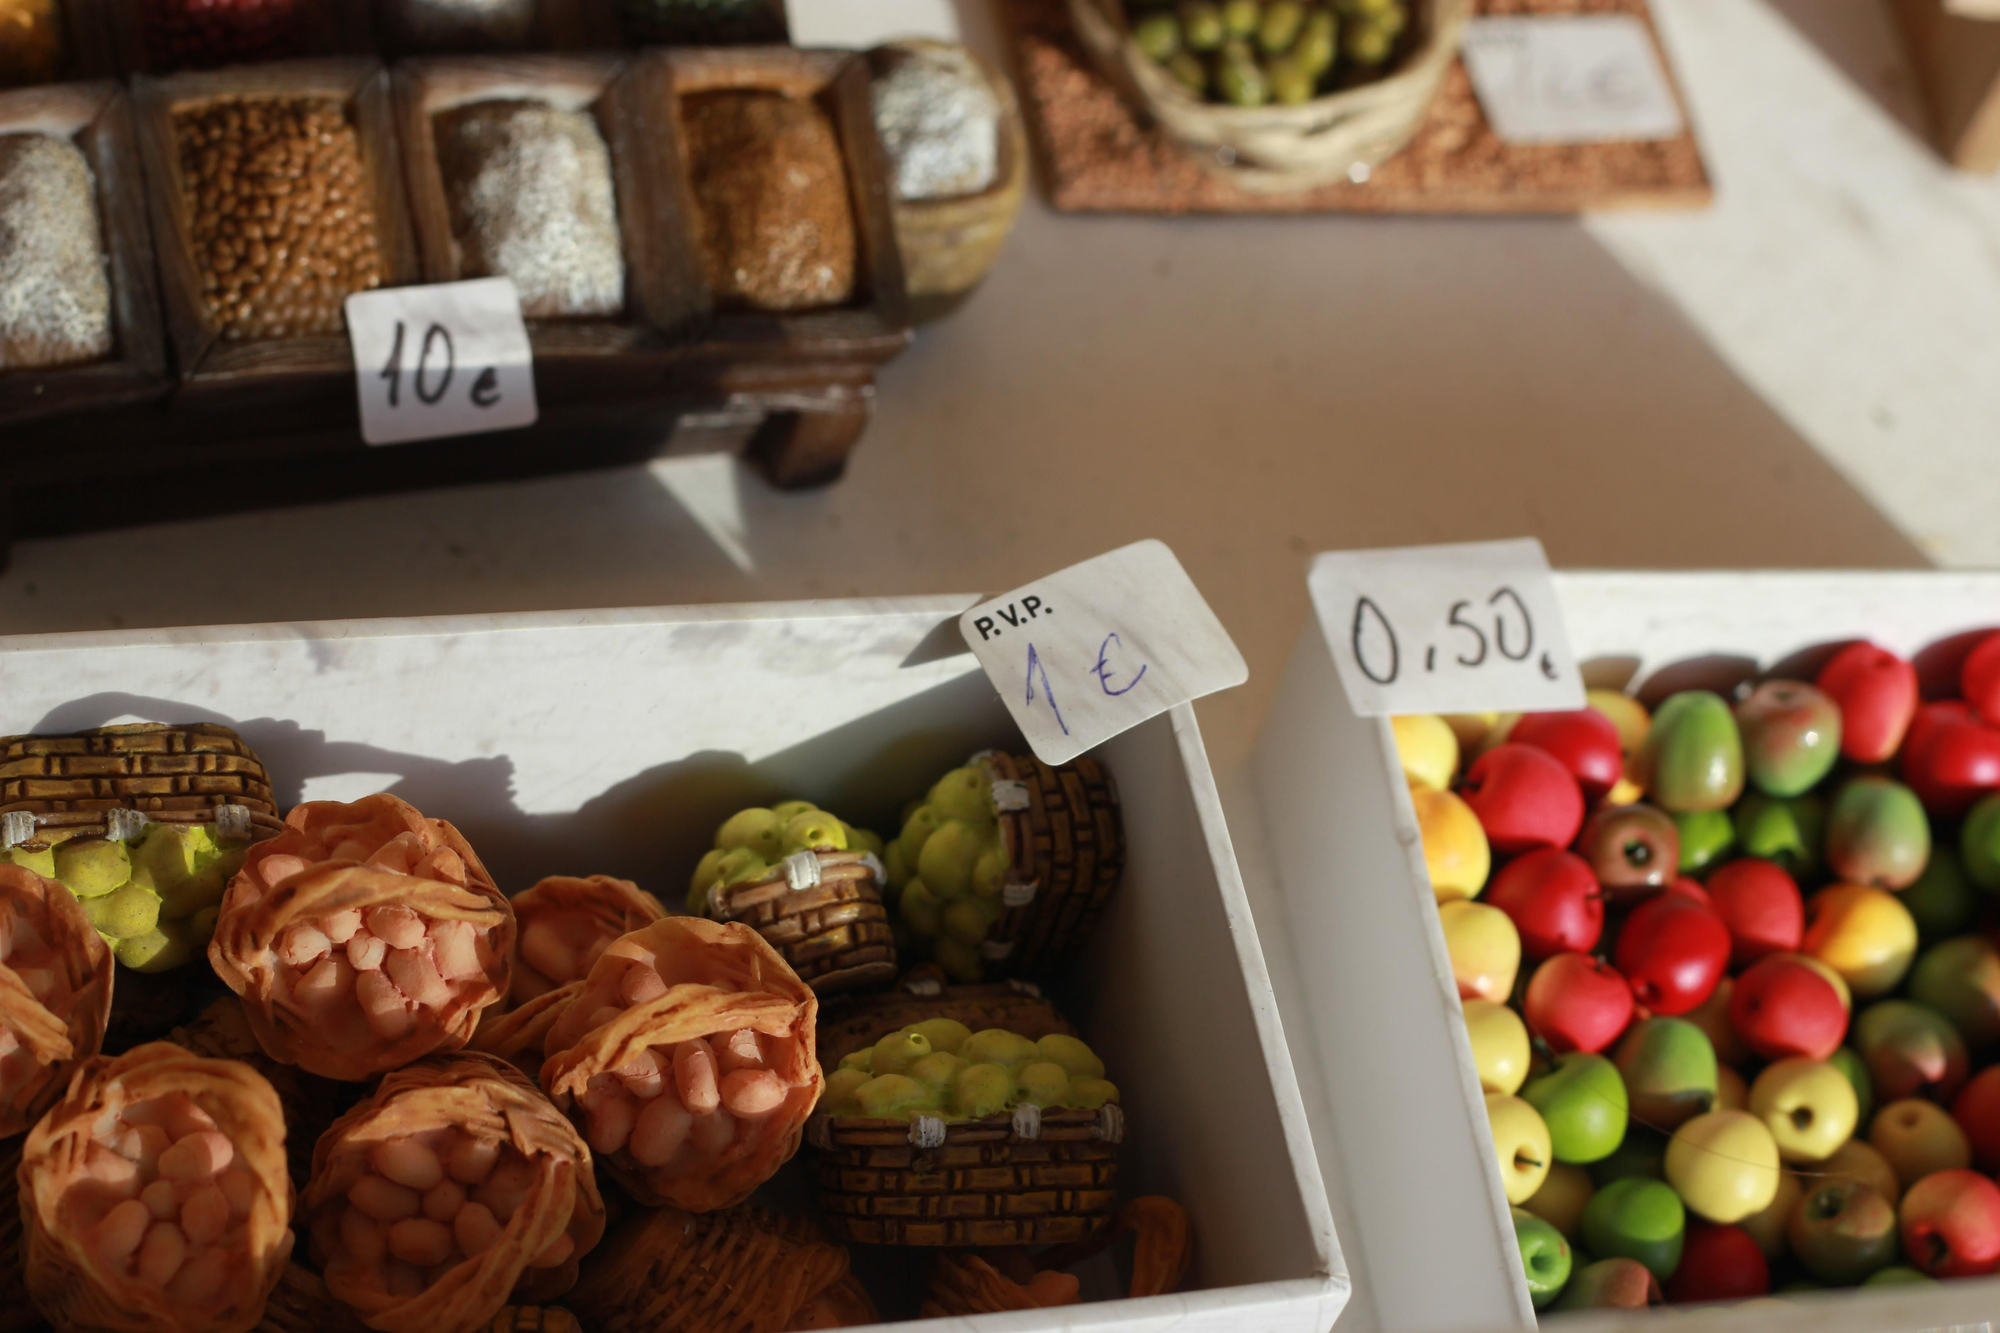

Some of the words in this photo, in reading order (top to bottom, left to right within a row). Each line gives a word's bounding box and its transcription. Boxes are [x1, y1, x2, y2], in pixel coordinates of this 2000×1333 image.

[379, 320, 454, 408] 10
[974, 595, 1053, 641] P.V.P.
[1353, 586, 1534, 686] 0,50
[1026, 642, 1069, 736] 1
[1089, 632, 1147, 696] €
